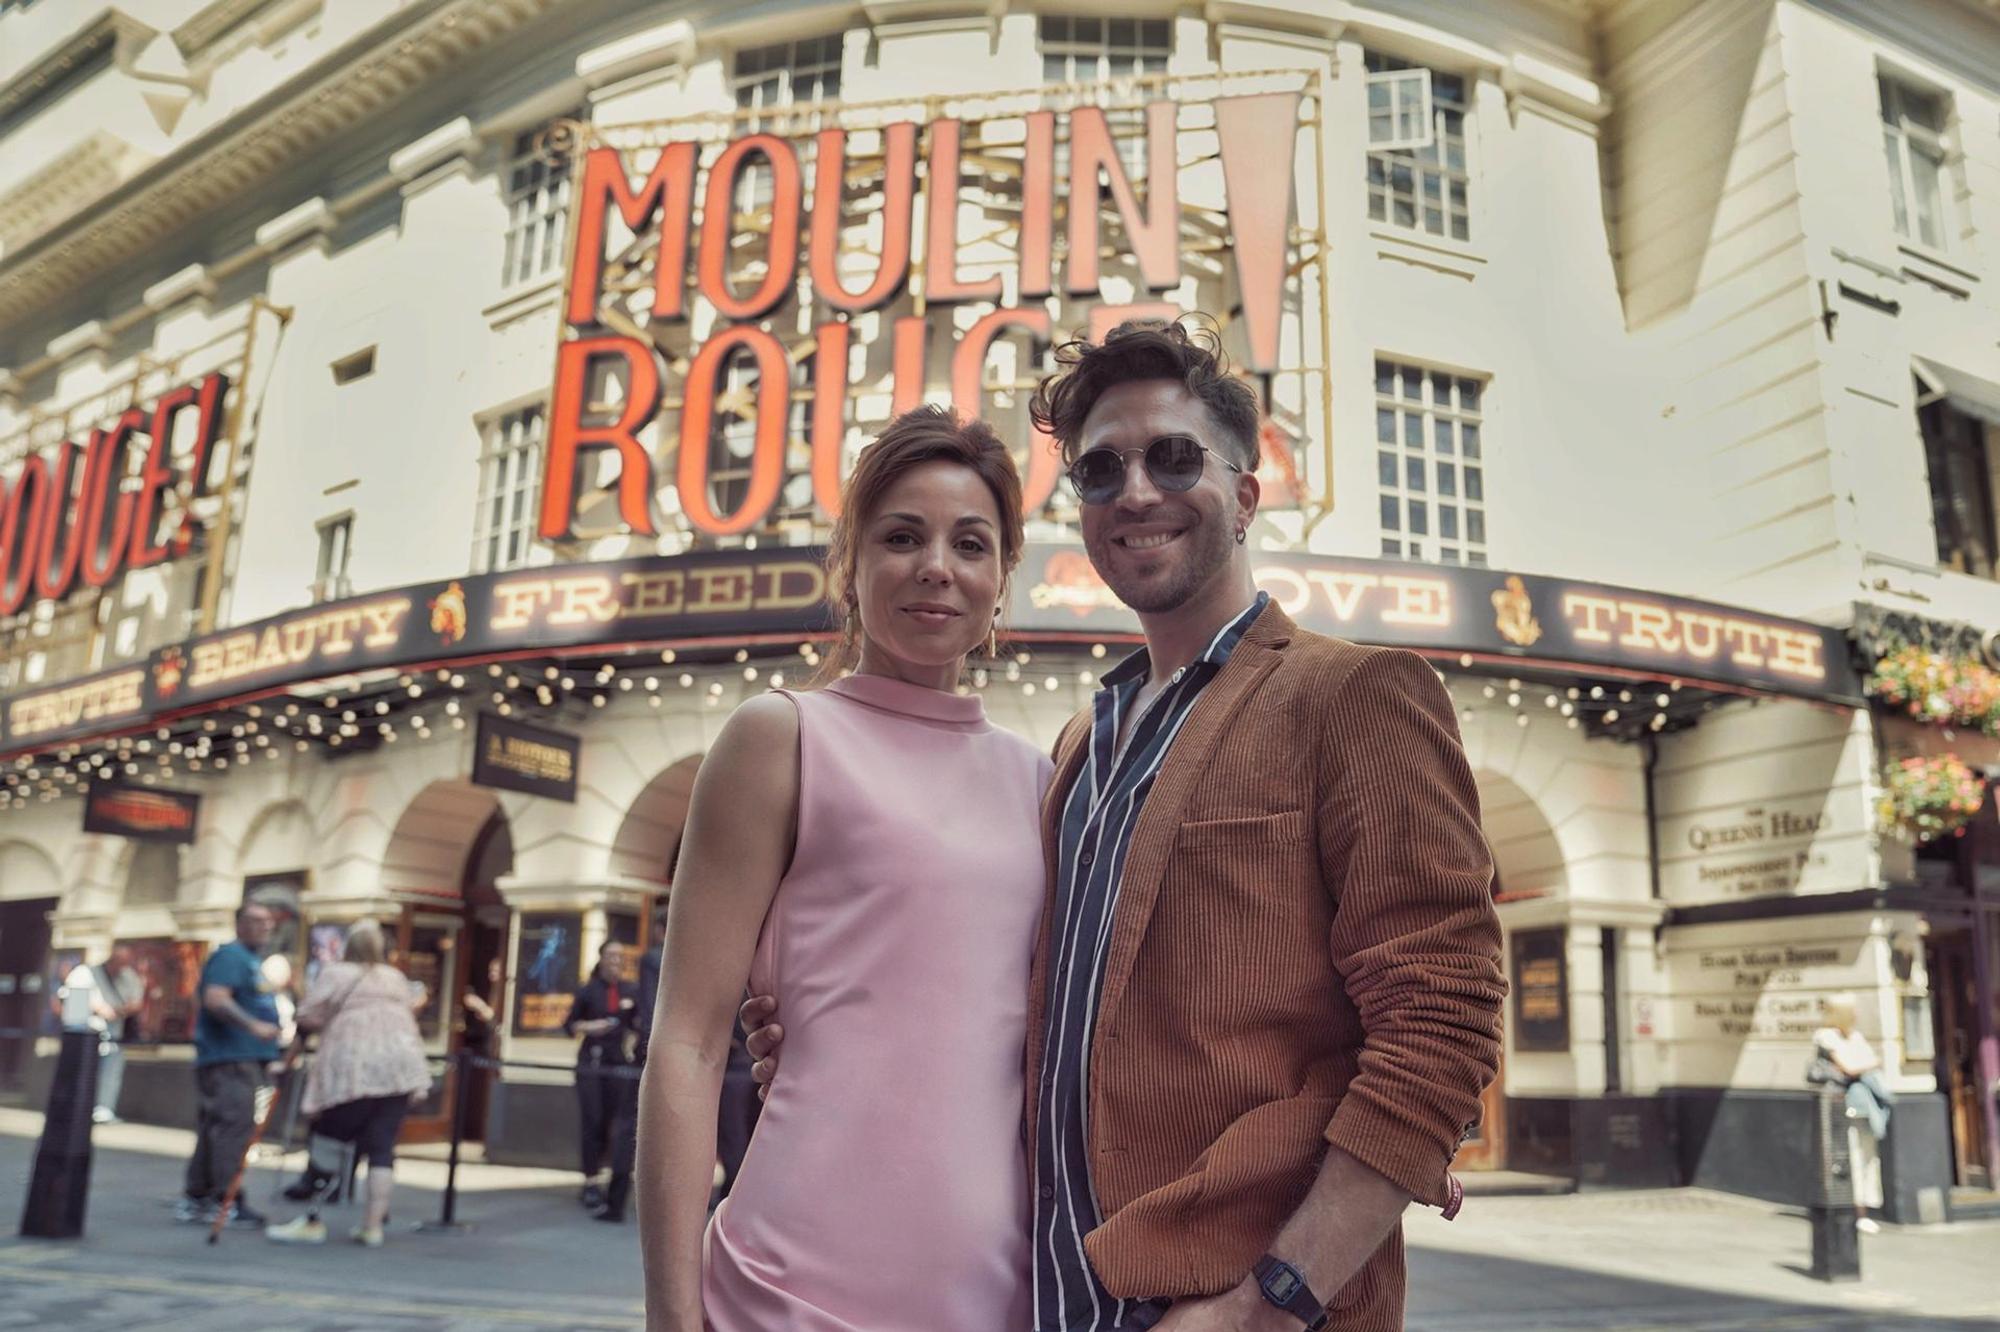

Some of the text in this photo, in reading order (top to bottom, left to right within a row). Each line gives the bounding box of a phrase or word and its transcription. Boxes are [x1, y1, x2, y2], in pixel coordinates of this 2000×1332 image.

[537, 303, 1184, 540] ROUG
[0, 372, 222, 616] OUGE!
[489, 561, 836, 631] FREED
[1254, 566, 1451, 628] OVE
[1562, 593, 1826, 680] TRUTH
[188, 598, 413, 689] BEAUTY
[9, 669, 146, 738] TRUTH
